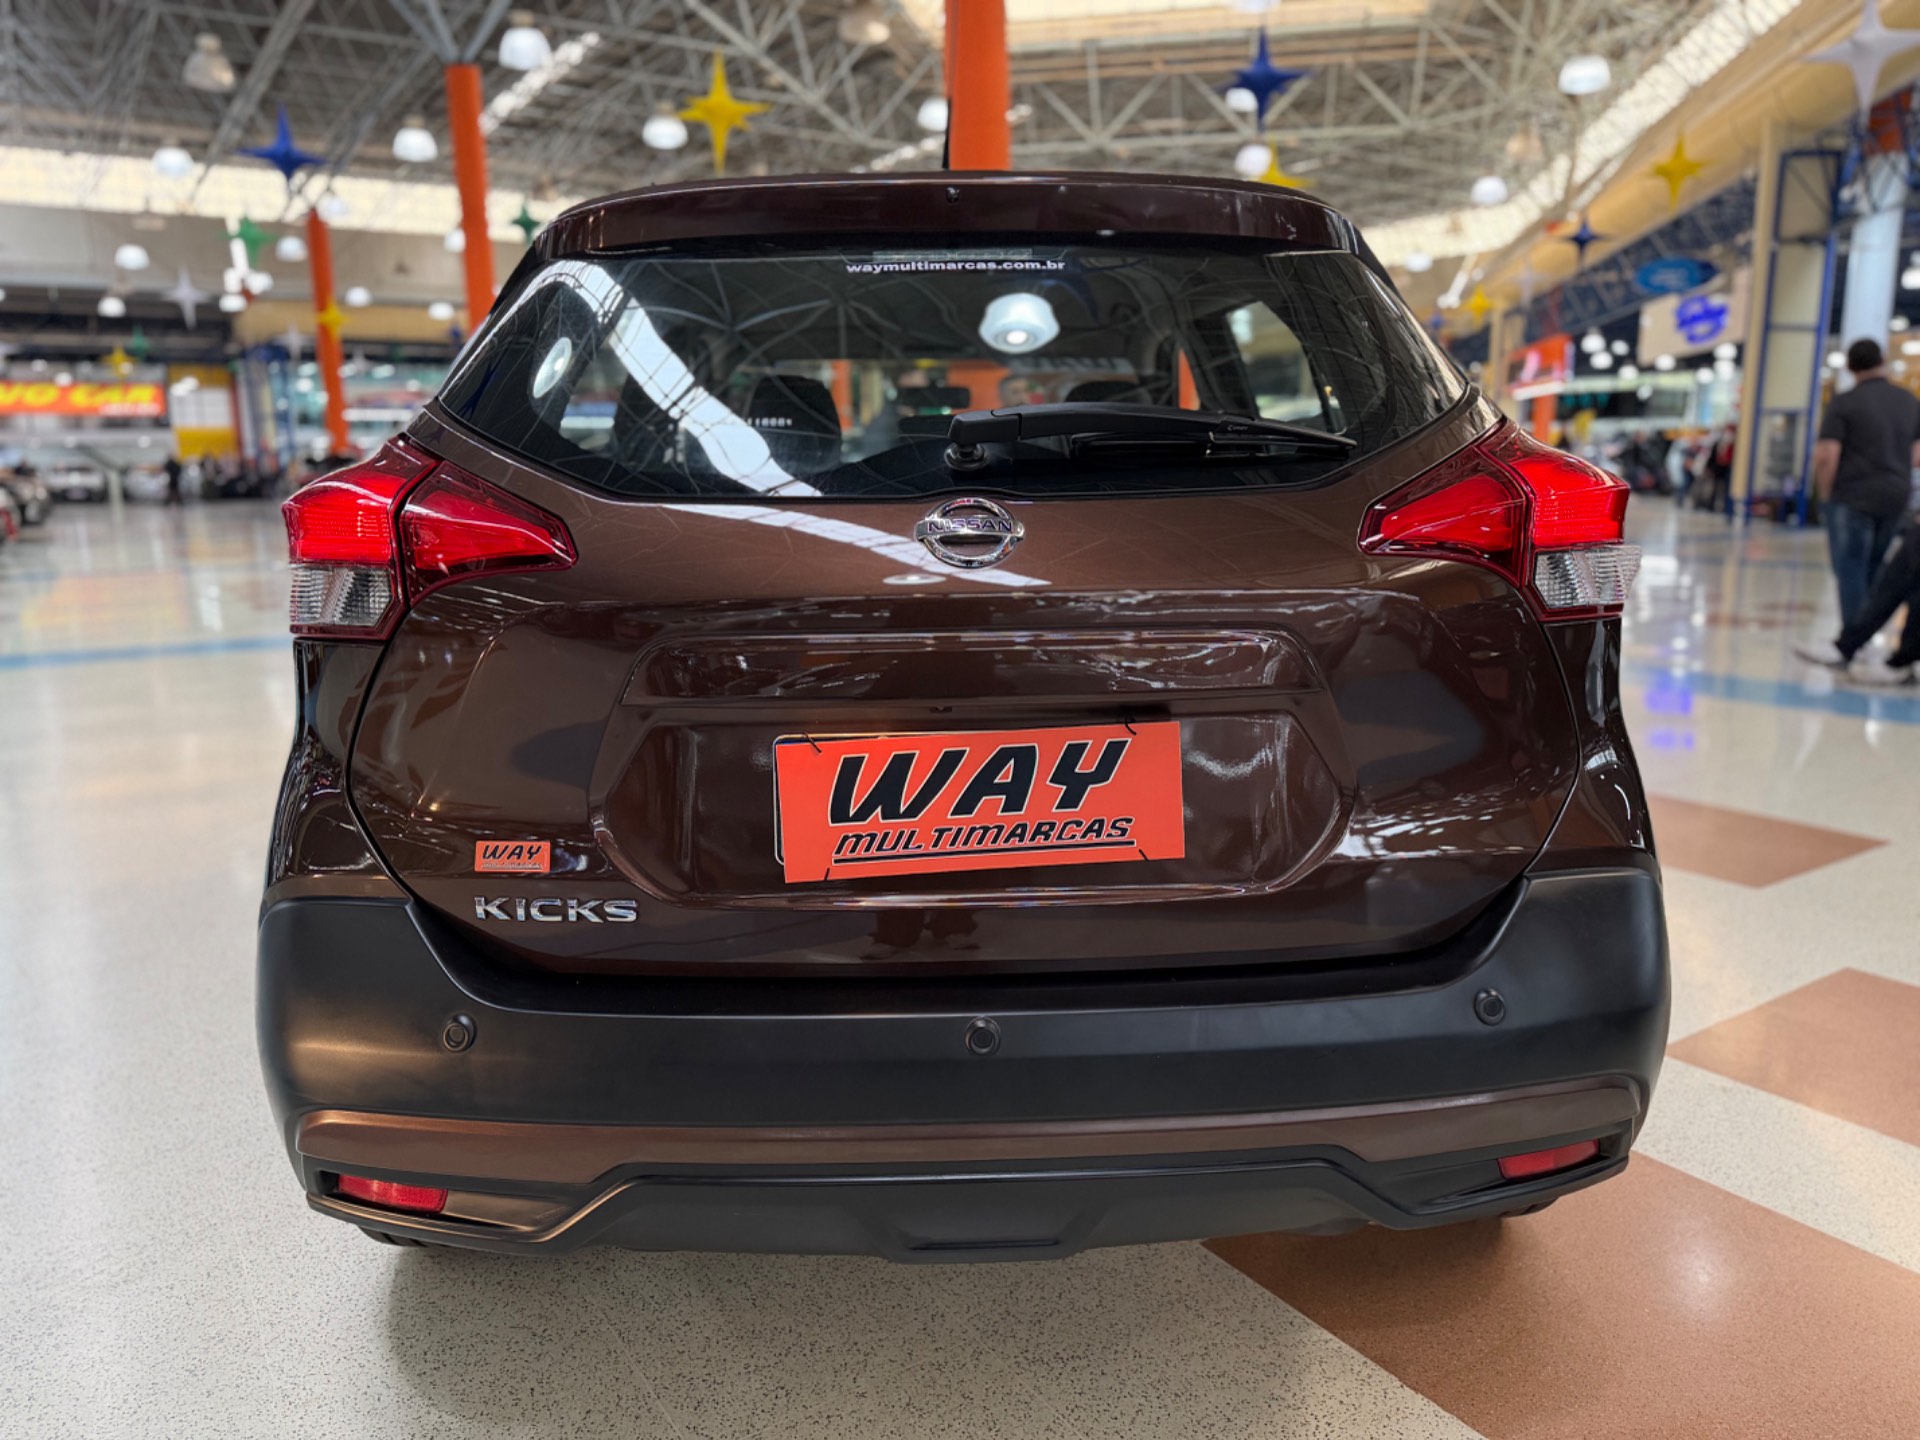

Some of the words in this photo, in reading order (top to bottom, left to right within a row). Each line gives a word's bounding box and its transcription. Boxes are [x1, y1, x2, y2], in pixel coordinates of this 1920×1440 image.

[846, 260, 1066, 274] waymultimarcas.com.br
[927, 518, 1013, 532] NISSAN
[828, 738, 1132, 826] WAY
[833, 817, 1135, 857] MULTIMARCAS
[482, 844, 542, 860] WAY
[474, 896, 638, 923] KICKS
